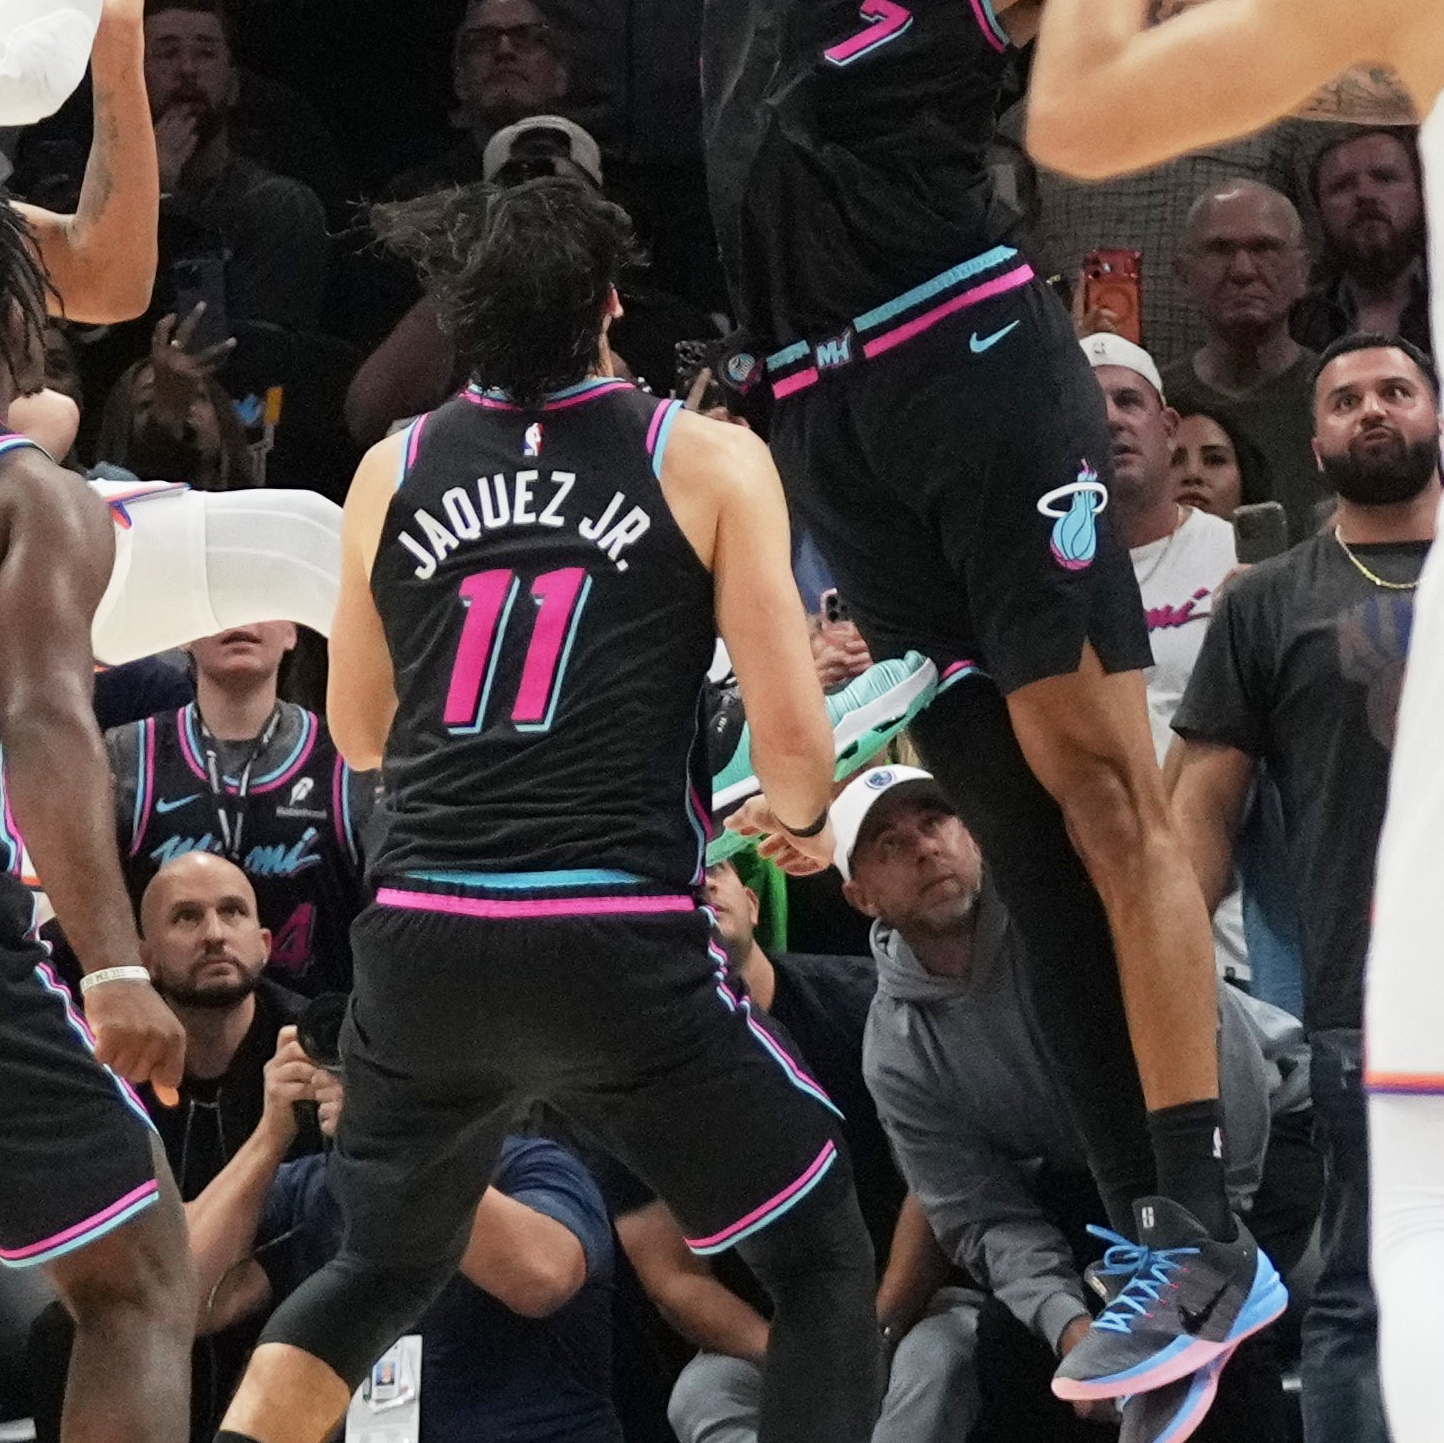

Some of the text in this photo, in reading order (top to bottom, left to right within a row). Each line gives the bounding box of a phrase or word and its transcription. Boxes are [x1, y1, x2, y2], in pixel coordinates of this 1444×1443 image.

[397, 469, 652, 581] JAQUEZ JR.
[442, 565, 594, 734] 11
[270, 903, 317, 975] 4
